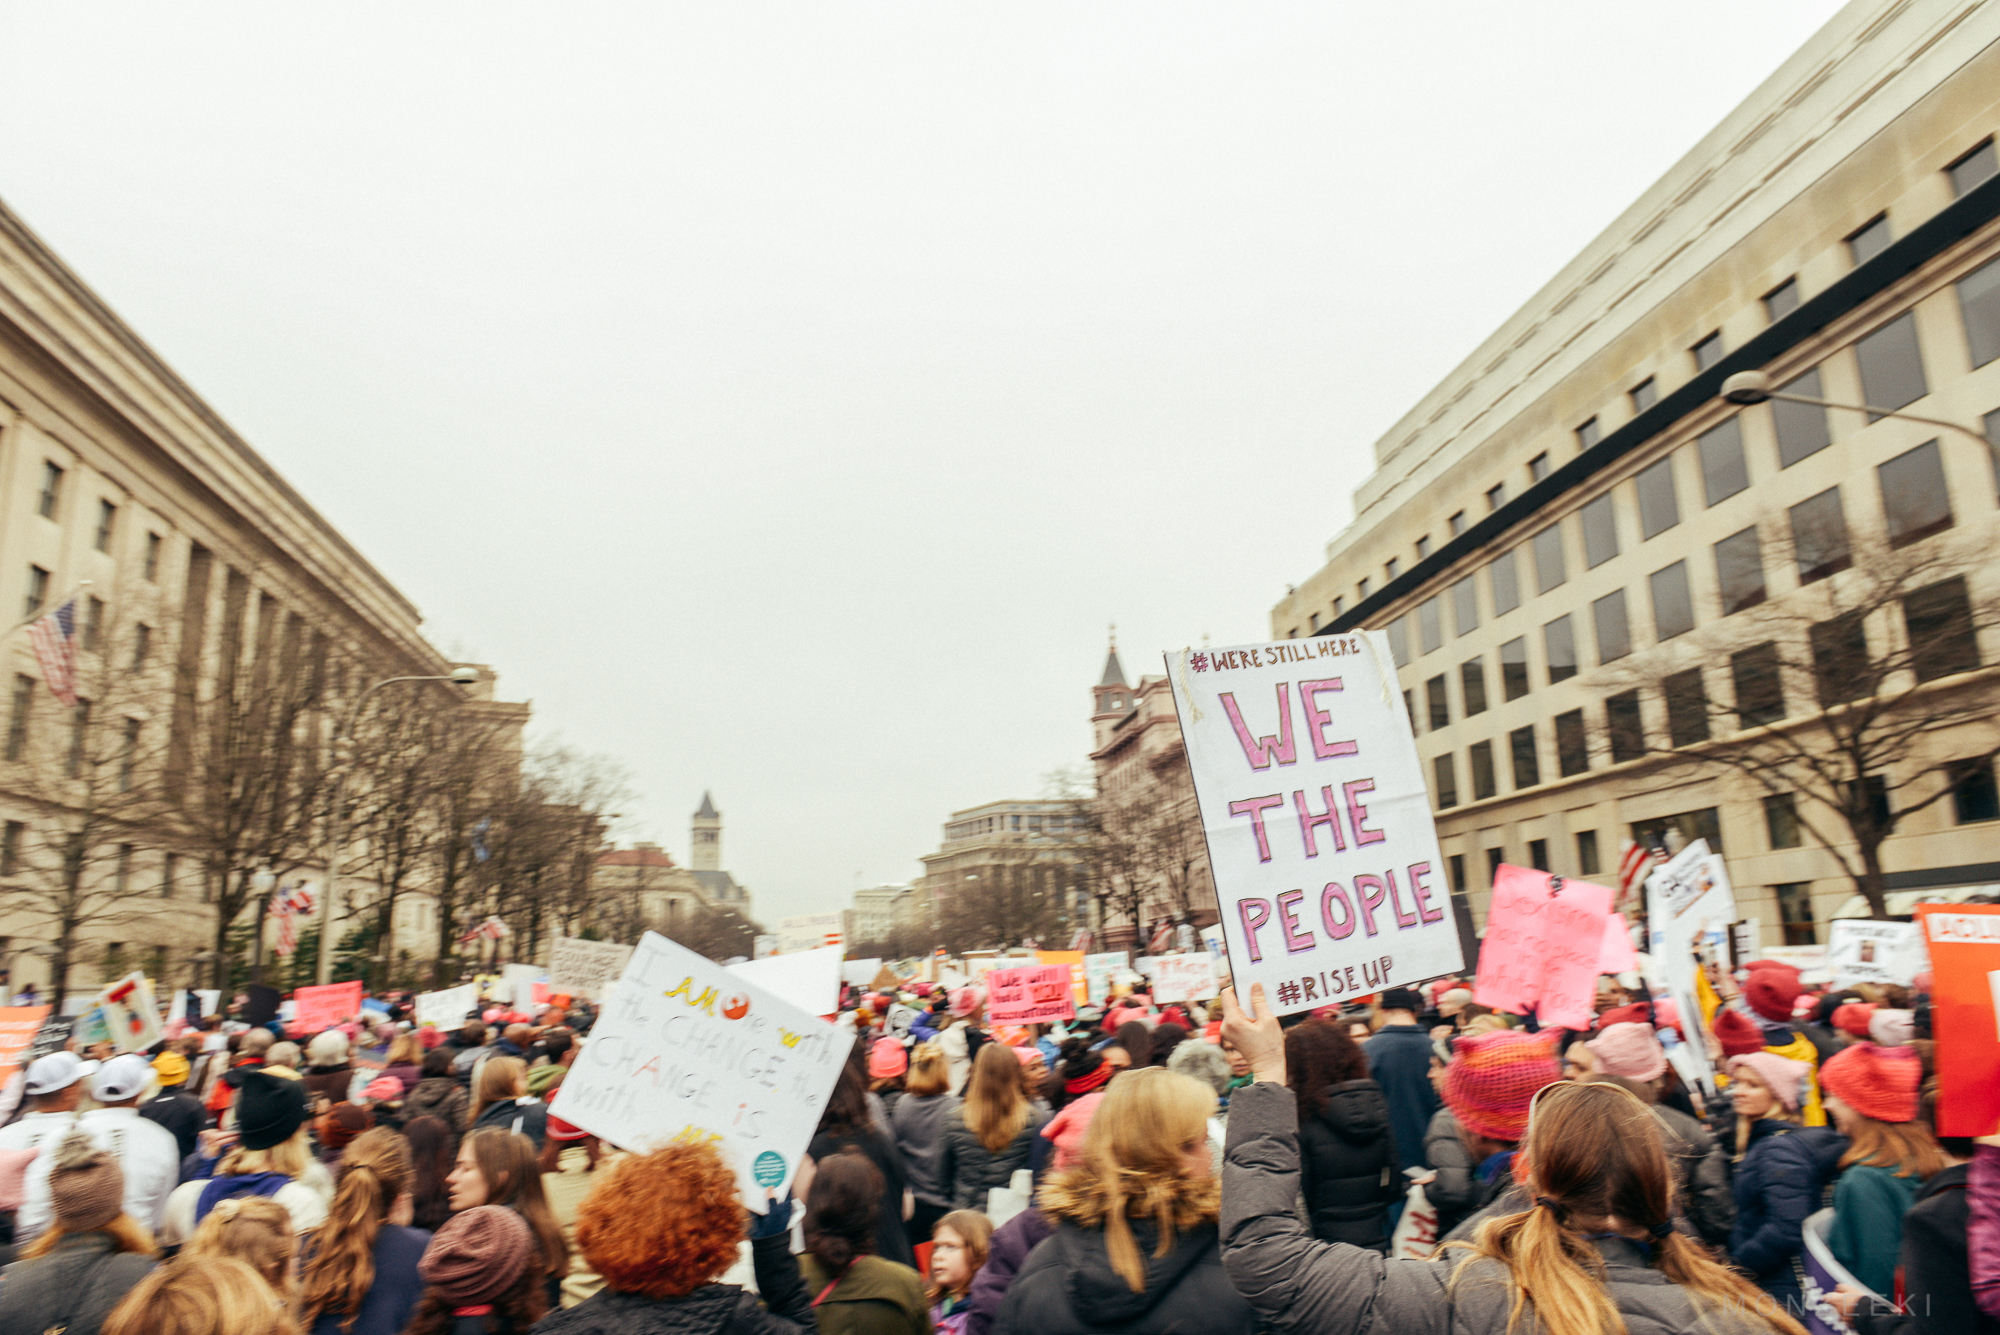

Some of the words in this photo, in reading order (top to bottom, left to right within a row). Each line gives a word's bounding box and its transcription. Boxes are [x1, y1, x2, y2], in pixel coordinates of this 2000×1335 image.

[1217, 676, 1359, 773] WE
[1227, 777, 1386, 864] THE
[1237, 861, 1444, 965] PEOPLE
[626, 944, 668, 988] I
[663, 976, 721, 1017] AM
[589, 1035, 719, 1109] CHANGE
